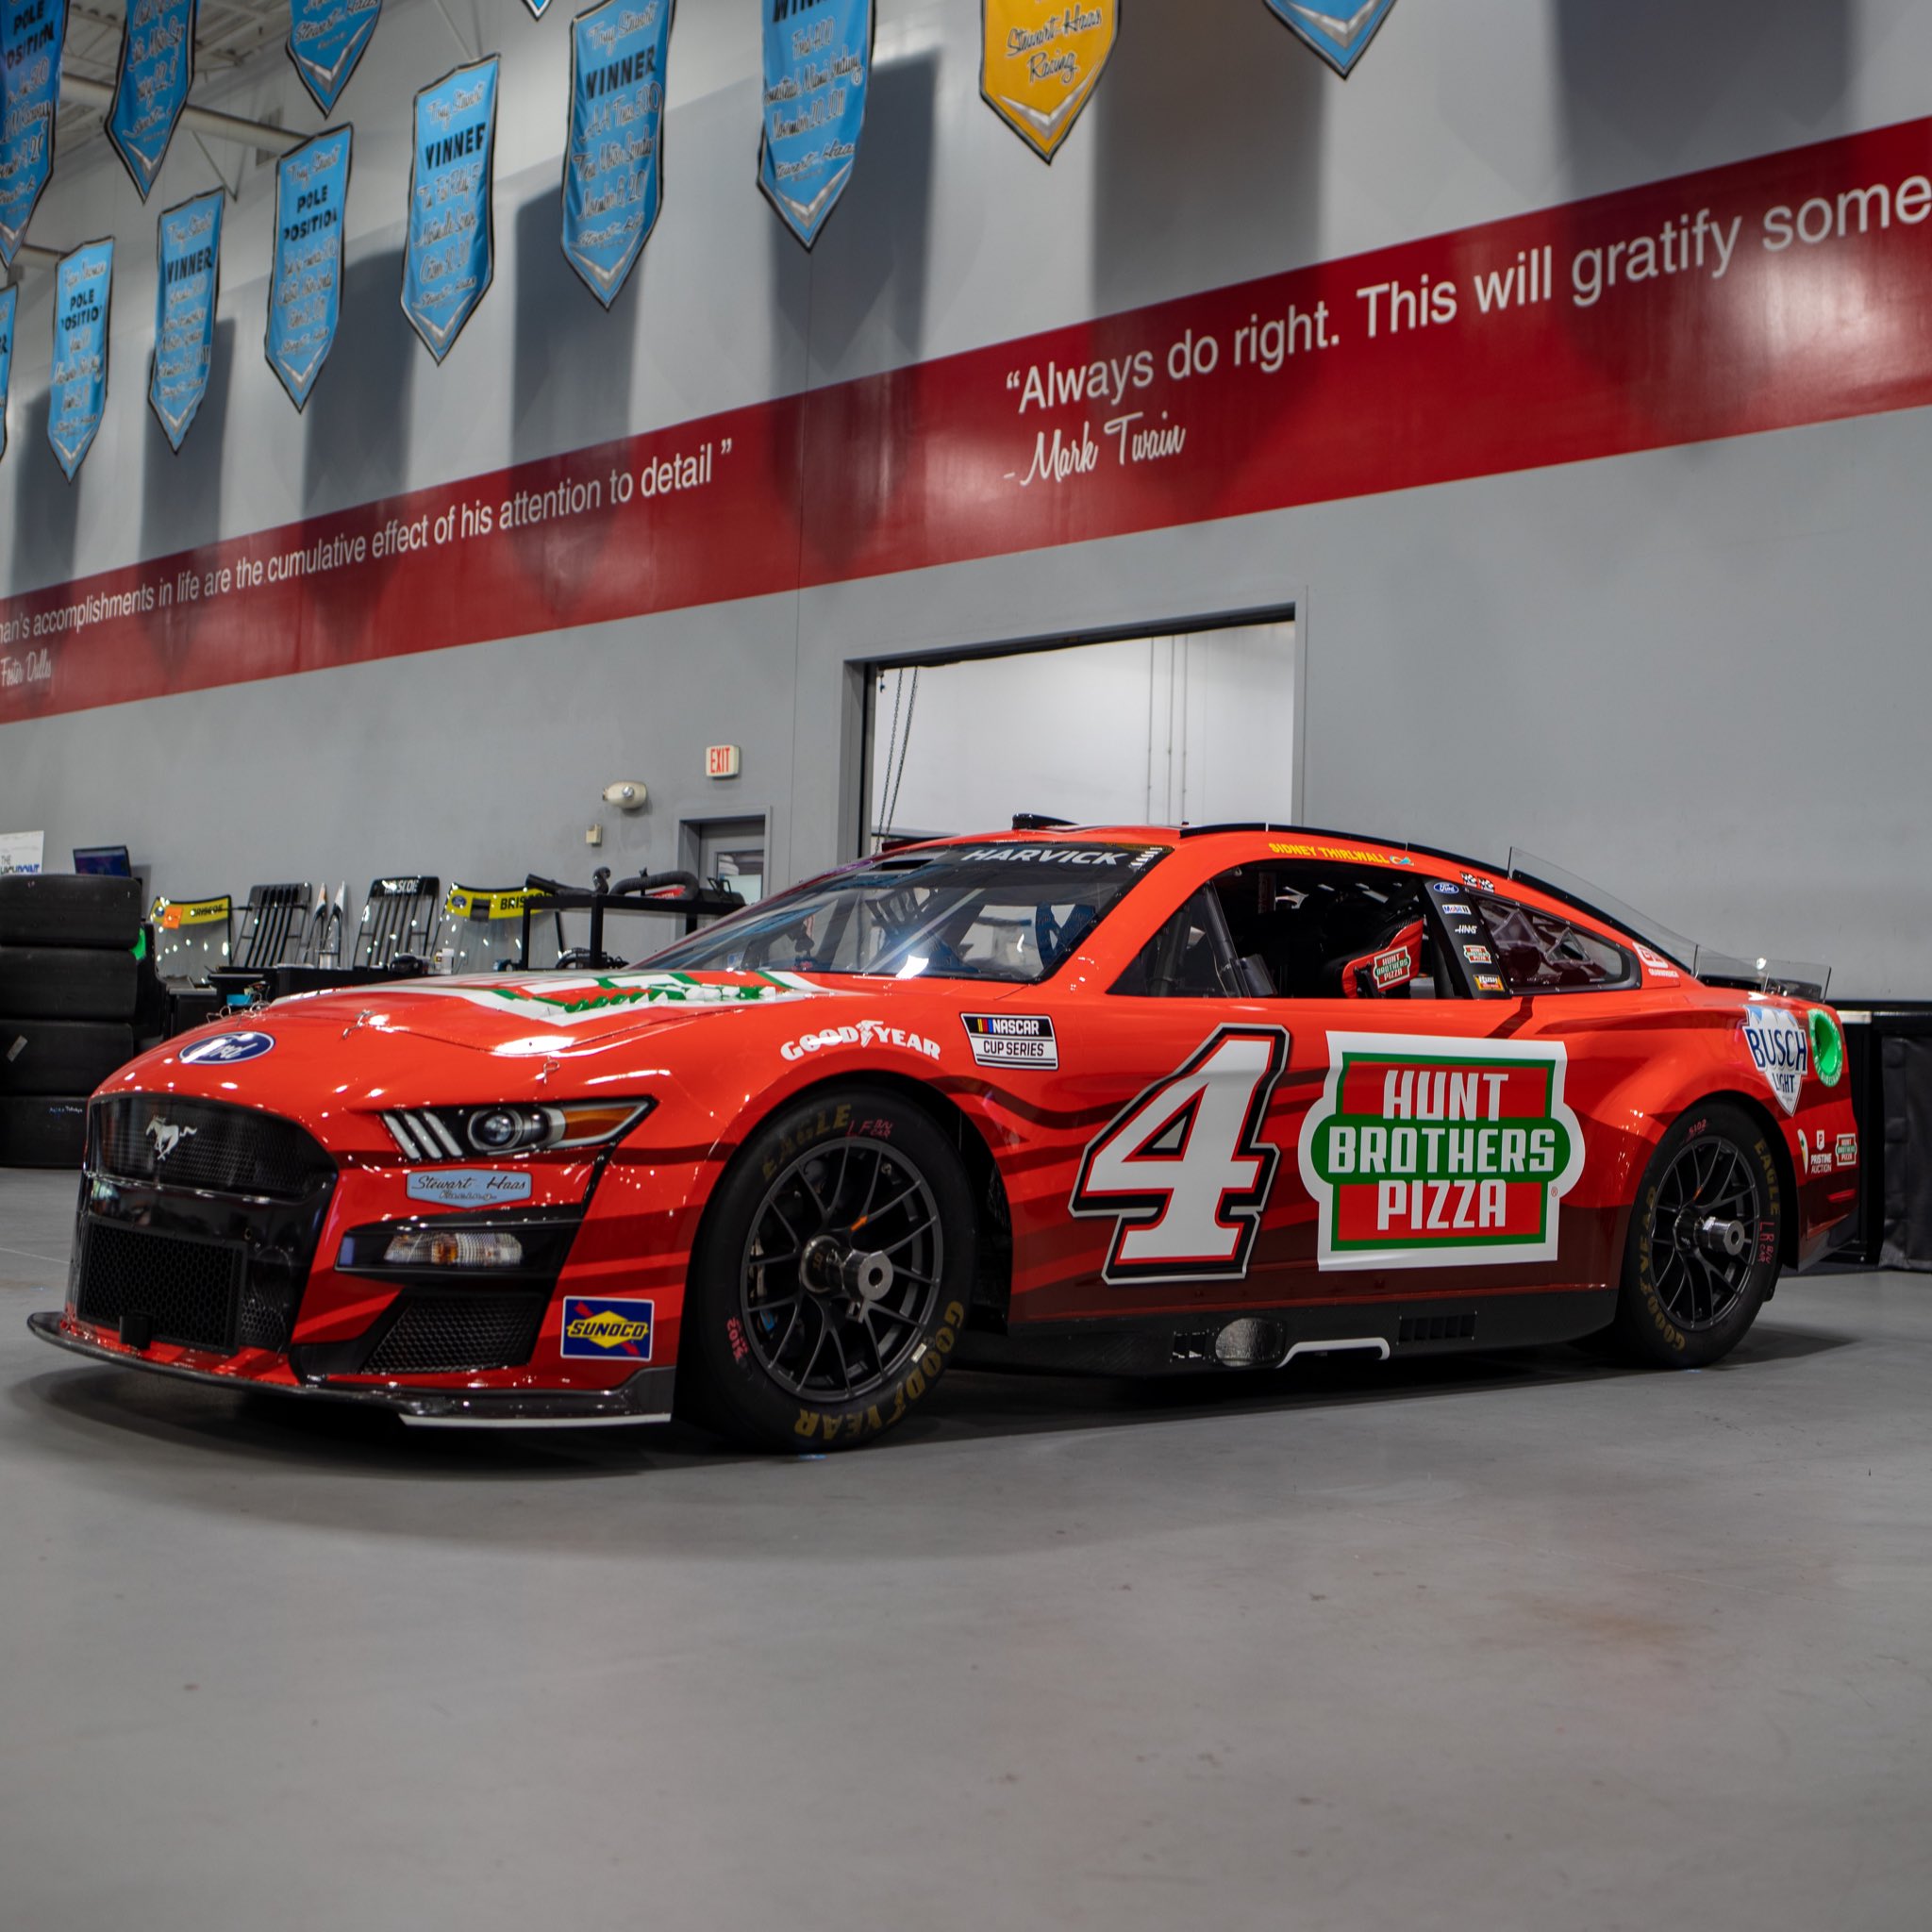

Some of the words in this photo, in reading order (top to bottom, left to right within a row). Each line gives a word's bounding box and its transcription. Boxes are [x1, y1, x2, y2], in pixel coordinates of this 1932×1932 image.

[1028, 48, 1077, 86] Racing
[296, 184, 328, 214] POLE
[1167, 328, 1219, 380] do
[1233, 300, 1340, 373] right.
[1357, 274, 1457, 339] This
[1474, 245, 1553, 313] will
[1571, 208, 1743, 308] gratify
[1762, 175, 1932, 252] some
[70, 288, 94, 312] POLE
[1020, 420, 1099, 486] Mark
[1103, 409, 1187, 466] Twain
[33, 584, 155, 634] accomplishments
[158, 577, 173, 607] in
[176, 570, 200, 603] life
[204, 568, 232, 596] are
[236, 557, 263, 590] the
[268, 533, 366, 583] cumulative
[371, 514, 430, 558] effect
[434, 505, 457, 545] of
[460, 499, 492, 539] his
[499, 477, 602, 531] attention
[609, 469, 634, 505] to
[641, 441, 713, 498] detail
[709, 746, 730, 774] EXIT
[959, 848, 1130, 866] HARVICK
[1268, 841, 1319, 857] SIDNEY
[1318, 846, 1391, 864] THIRLWALL
[1382, 953, 1400, 965] HUNT
[1384, 968, 1403, 982] PIZZA
[991, 1017, 1040, 1036] NASCAR
[983, 1039, 1004, 1055] CUP
[1006, 1041, 1044, 1057] SERIES
[1746, 1027, 1807, 1072] BUSCH
[1382, 1069, 1509, 1123] HUNT
[762, 1103, 852, 1180] EAGLE
[1074, 1028, 1283, 1276] 4
[1327, 1125, 1556, 1174] BROTHERS
[1810, 1153, 1832, 1165] PRISTINE
[1811, 1163, 1832, 1174] AUCTION
[411, 1174, 476, 1190] Stewart
[486, 1174, 526, 1191] Haas
[1753, 1137, 1781, 1216] EAGLE
[1377, 1178, 1507, 1231] PIZZA
[570, 1321, 647, 1338] SUNOCO
